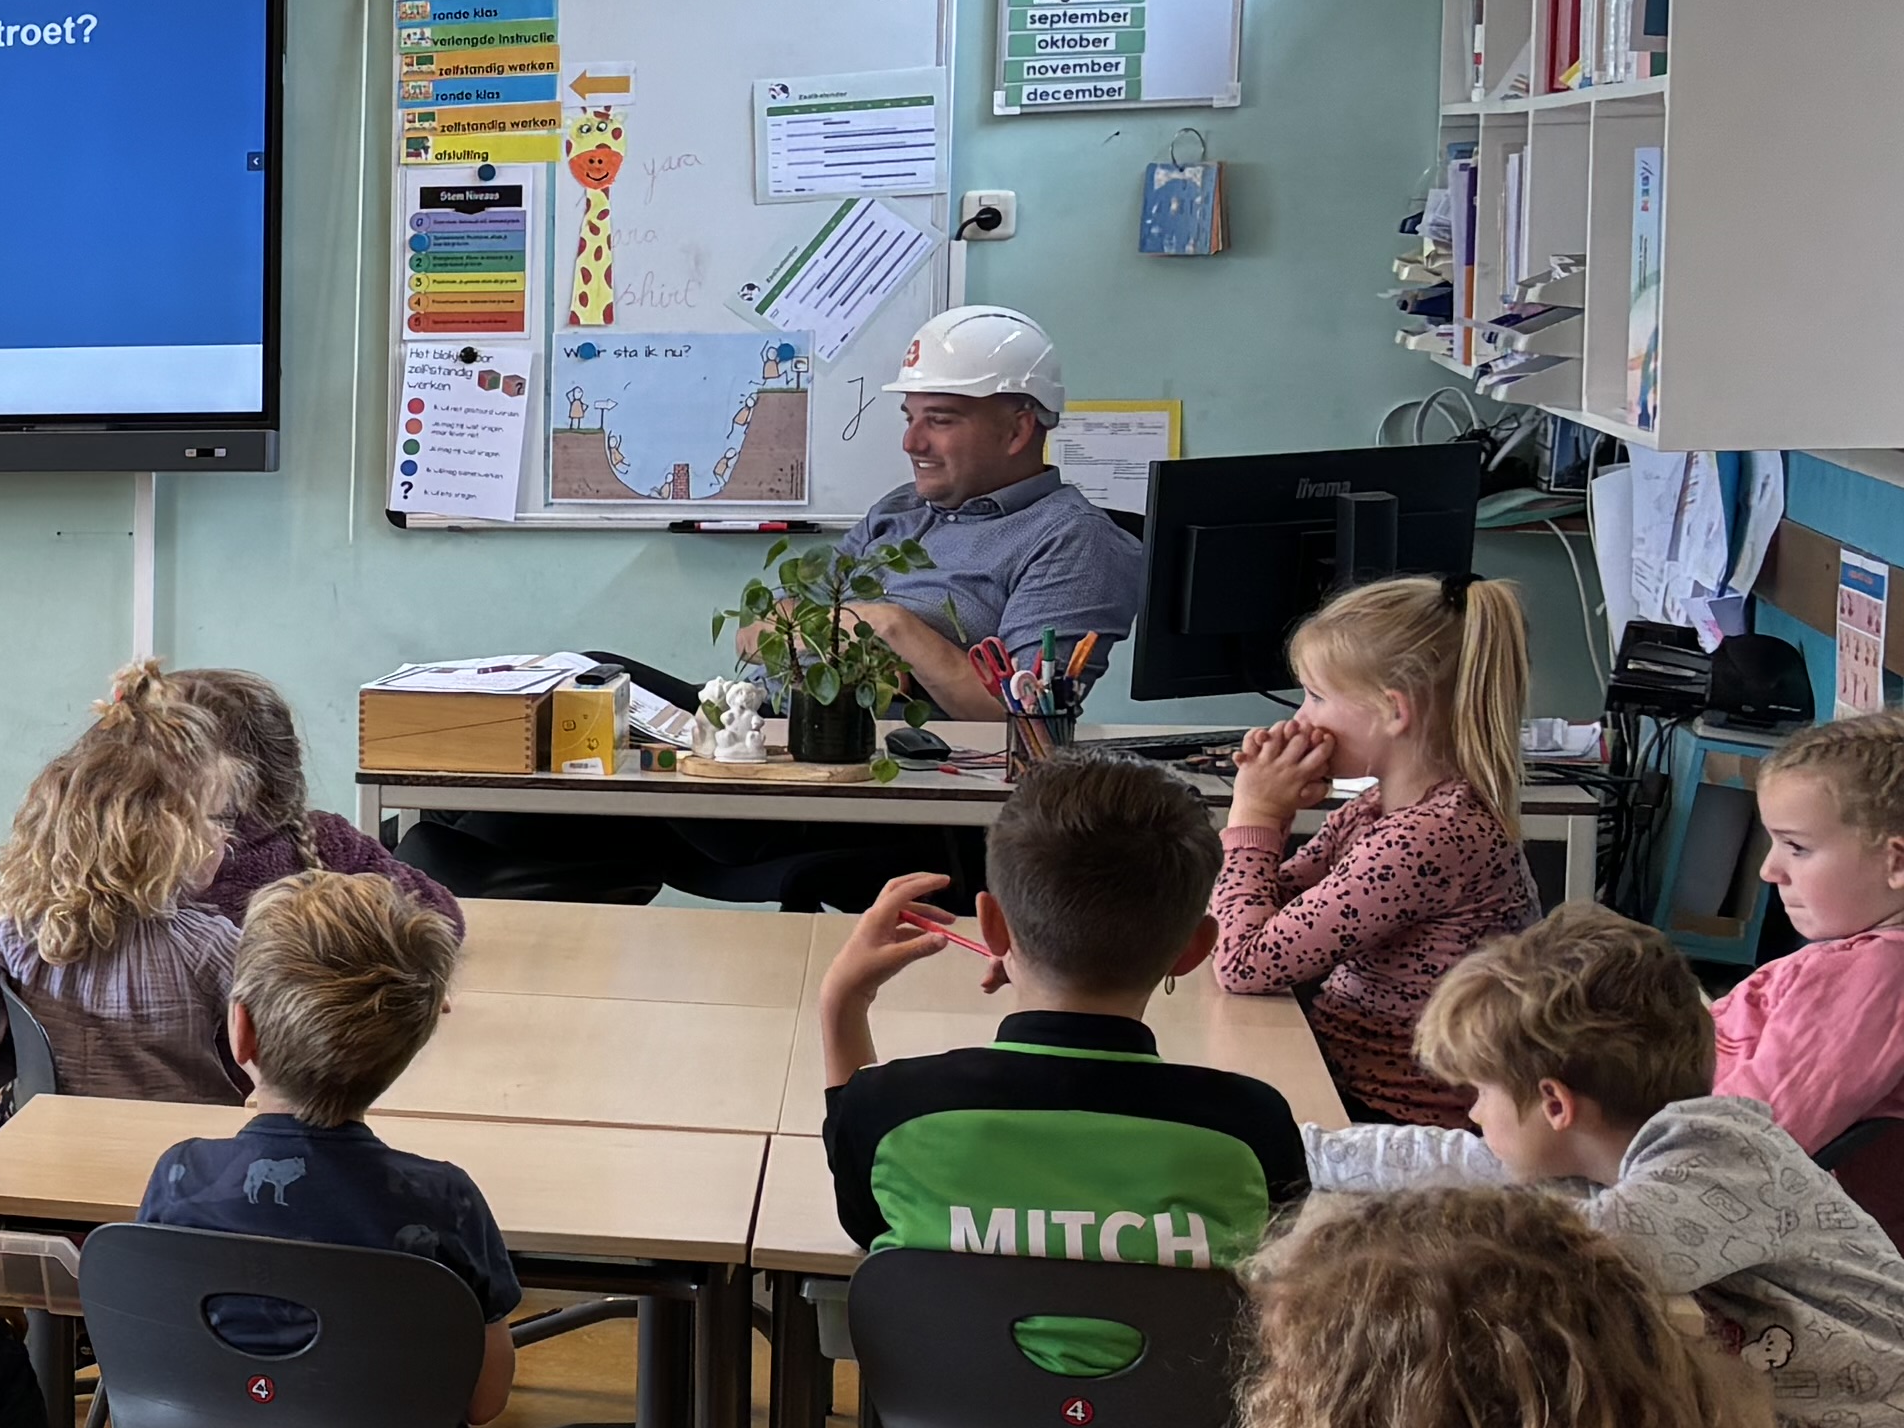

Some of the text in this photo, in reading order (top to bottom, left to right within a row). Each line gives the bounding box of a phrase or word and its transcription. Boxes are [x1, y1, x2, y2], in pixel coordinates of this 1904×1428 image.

[473, 7, 498, 18] klas
[1028, 9, 1129, 28] september
[1037, 34, 1110, 51] oktober
[1026, 59, 1121, 76] november
[476, 89, 500, 100] klas
[1026, 85, 1124, 102] december
[440, 190, 500, 201] Stem Niveaus
[415, 258, 423, 268] 2
[415, 278, 423, 288] 3
[414, 297, 421, 307] 4
[409, 348, 430, 359] Het
[613, 345, 638, 358] sta
[644, 344, 658, 357] ik
[664, 344, 691, 358] nu?
[407, 381, 451, 391] werken
[949, 1205, 1211, 1269] MITCH
[252, 1378, 269, 1399] 4
[1065, 1400, 1086, 1421] 4
